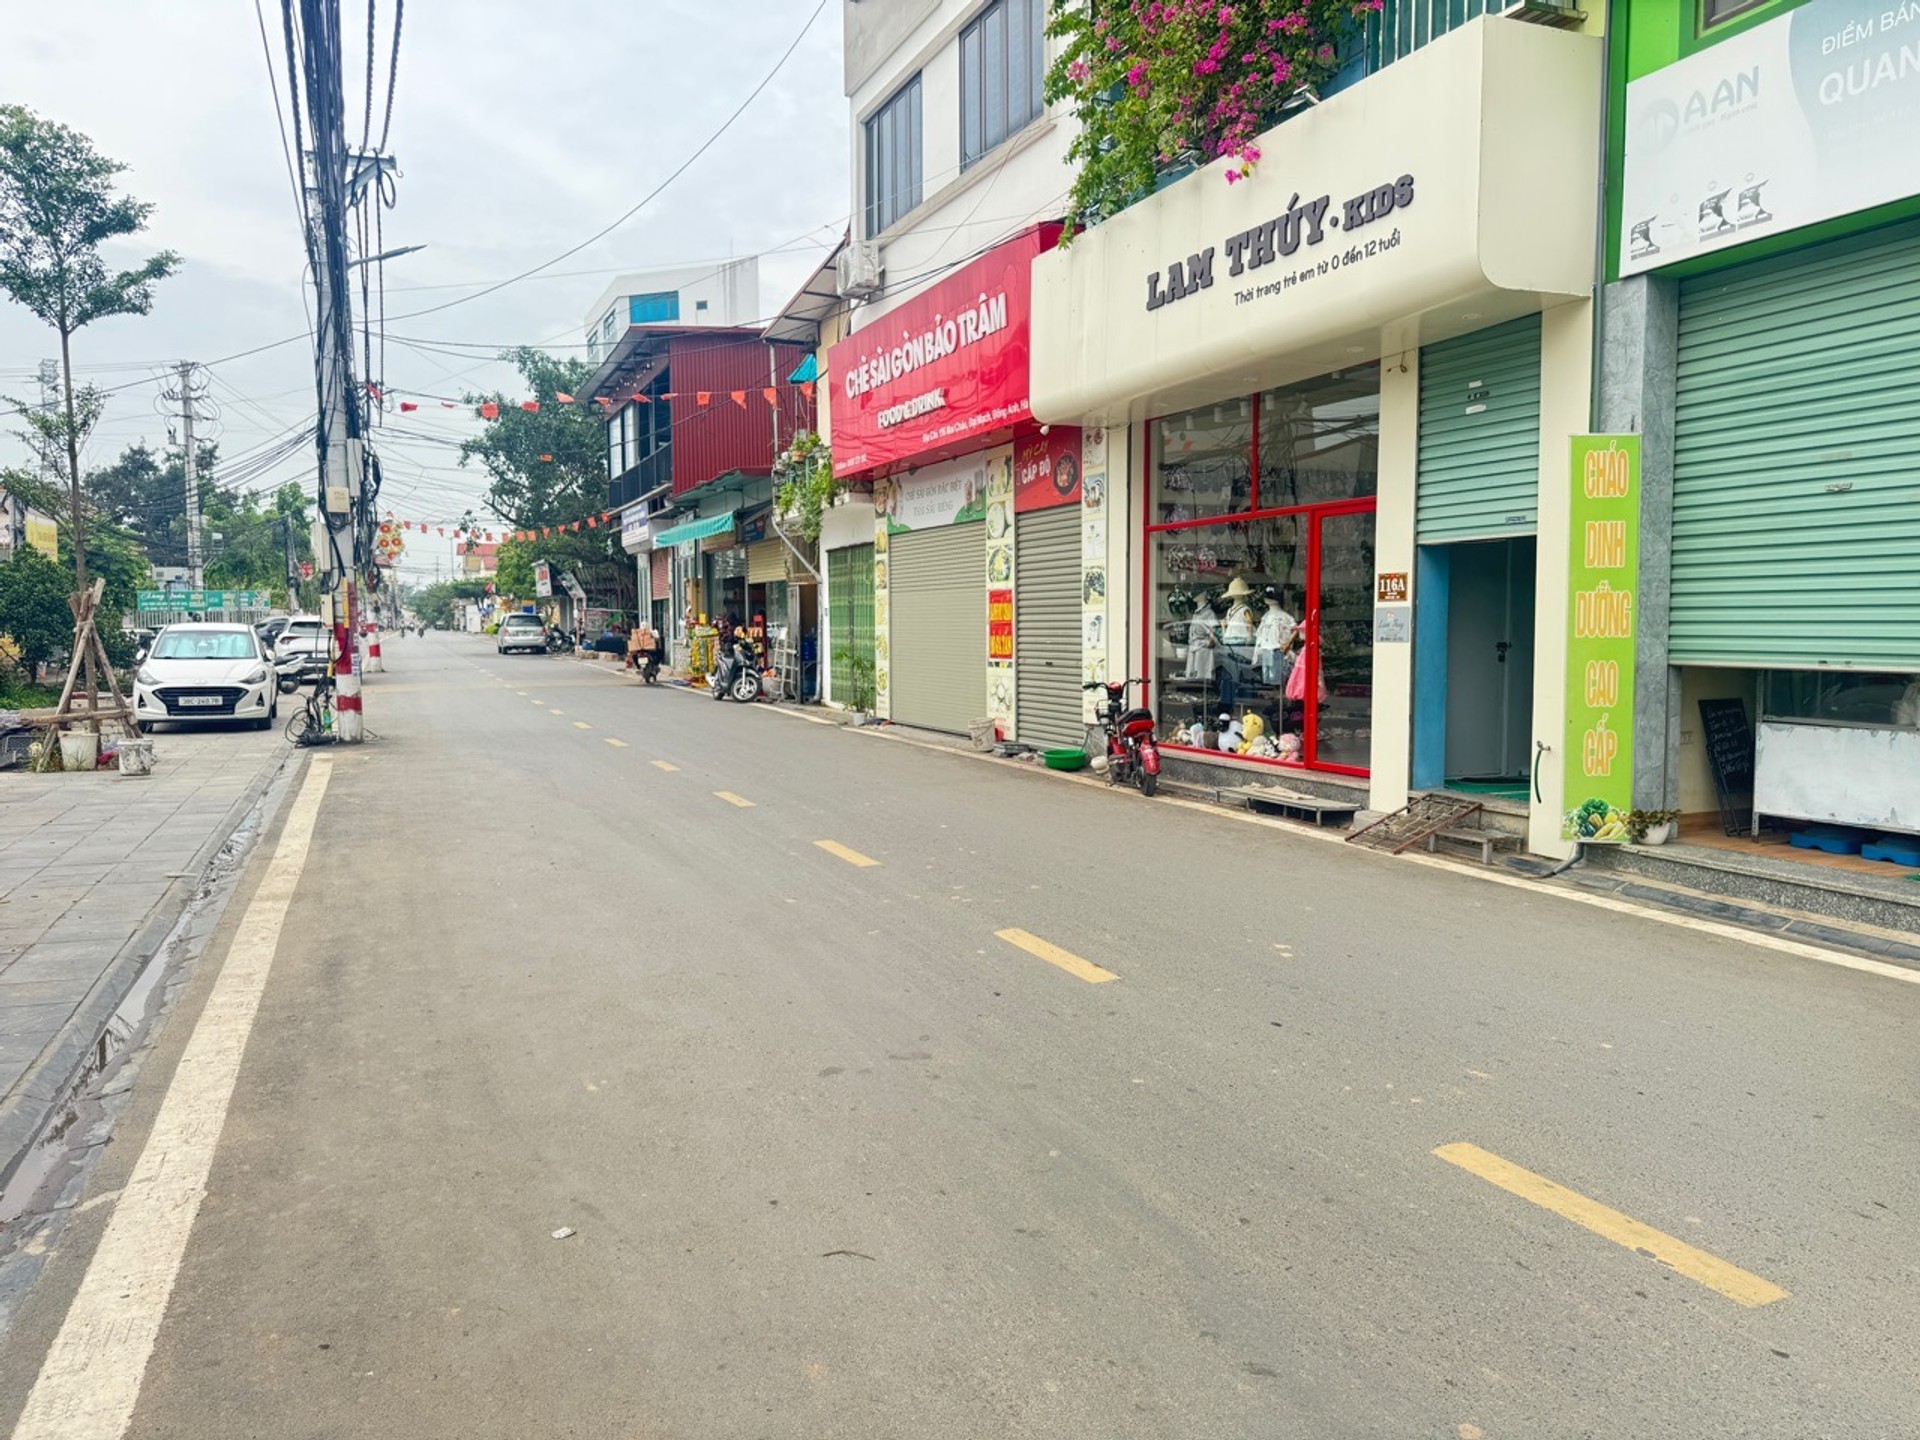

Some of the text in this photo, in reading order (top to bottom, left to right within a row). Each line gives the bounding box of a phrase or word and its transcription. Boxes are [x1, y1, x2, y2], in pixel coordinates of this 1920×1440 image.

[1822, 19, 1873, 55] ĐIỂM
[1146, 174, 1414, 311] LAM THÚY KIDS
[1234, 287, 1255, 306] Thời
[1256, 280, 1281, 301] trang
[1283, 270, 1298, 289] trẻ
[1299, 266, 1316, 283] em
[1317, 258, 1329, 277] từ
[1342, 244, 1363, 265] đến
[1364, 241, 1377, 258] 12
[1378, 228, 1401, 253] tuổi
[846, 292, 1008, 399] CHÈ SÀI GÒN BẢO TRÂM
[1022, 460, 1037, 484] CẤP
[1039, 454, 1051, 477] ĐỘ
[1584, 440, 1629, 498] CHÁO
[1585, 520, 1626, 568] DINH
[1380, 578, 1405, 592] 116A
[1575, 580, 1631, 638] DƯỠNG
[1585, 660, 1618, 707] CAO
[1583, 713, 1617, 776] CẤP
